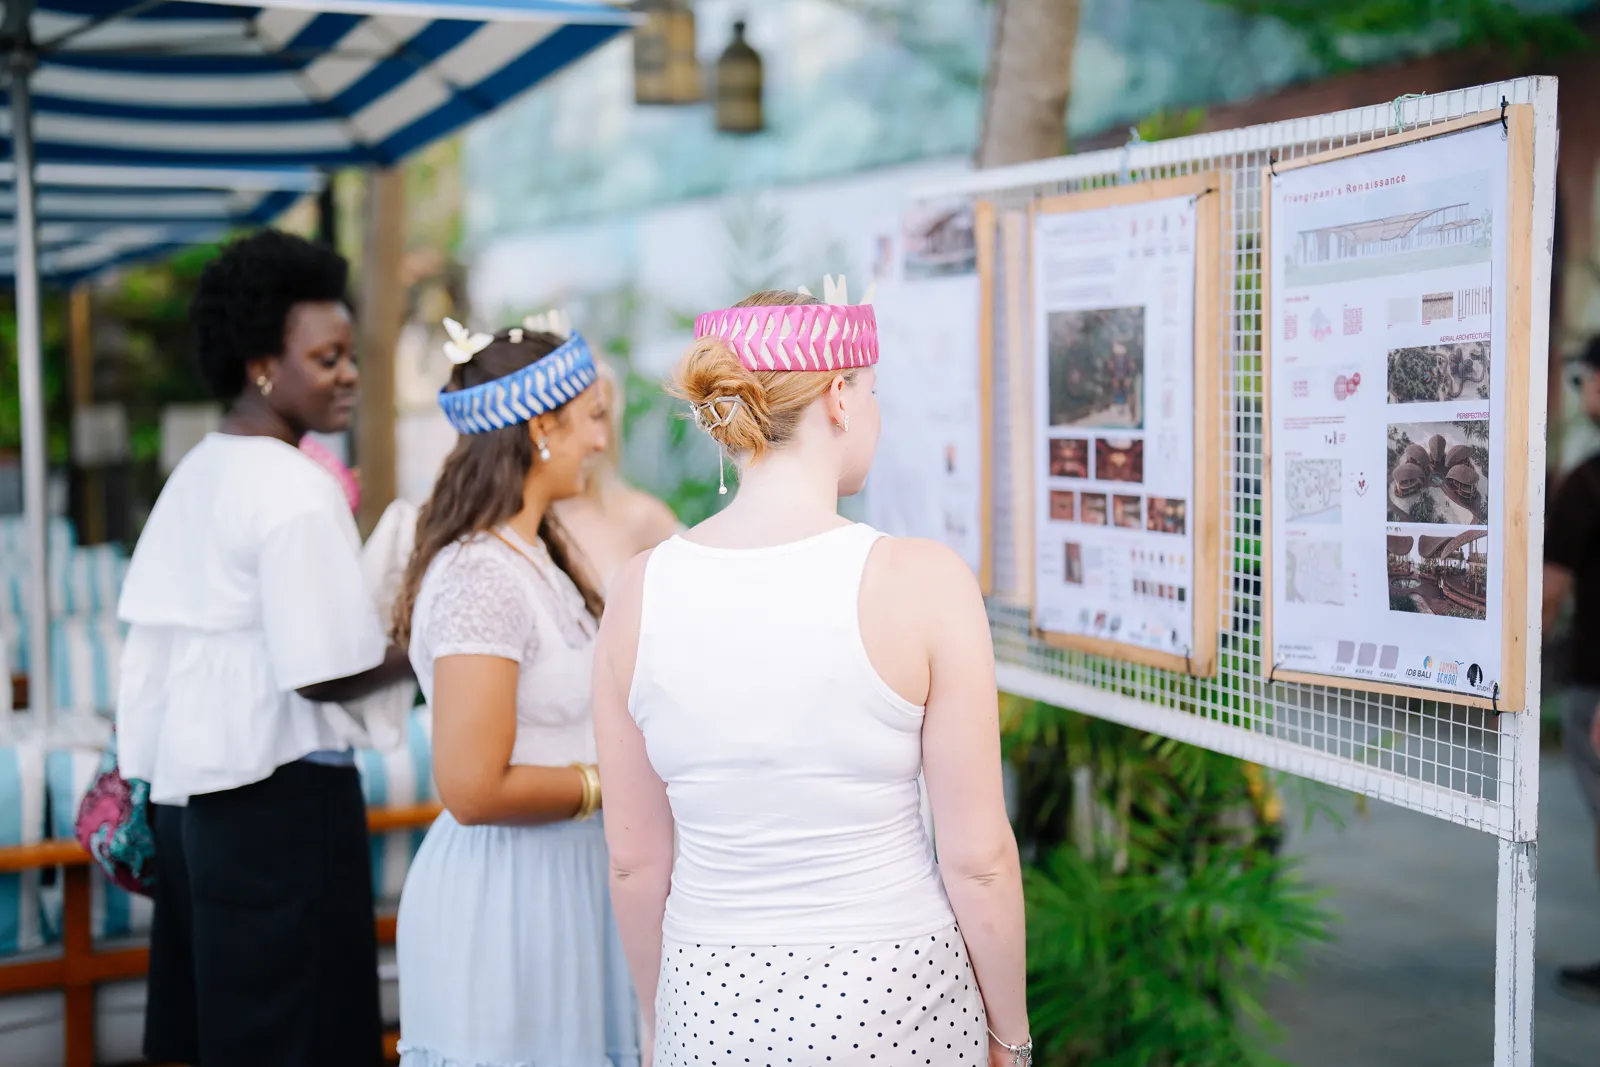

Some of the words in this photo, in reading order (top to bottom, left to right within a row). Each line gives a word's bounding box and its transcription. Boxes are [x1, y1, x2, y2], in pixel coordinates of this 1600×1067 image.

[1346, 174, 1406, 193] Renaissance
[1456, 332, 1490, 341] ARCHITECTURE
[1417, 669, 1432, 679] BALI
[1436, 672, 1458, 687] SCHOOL
